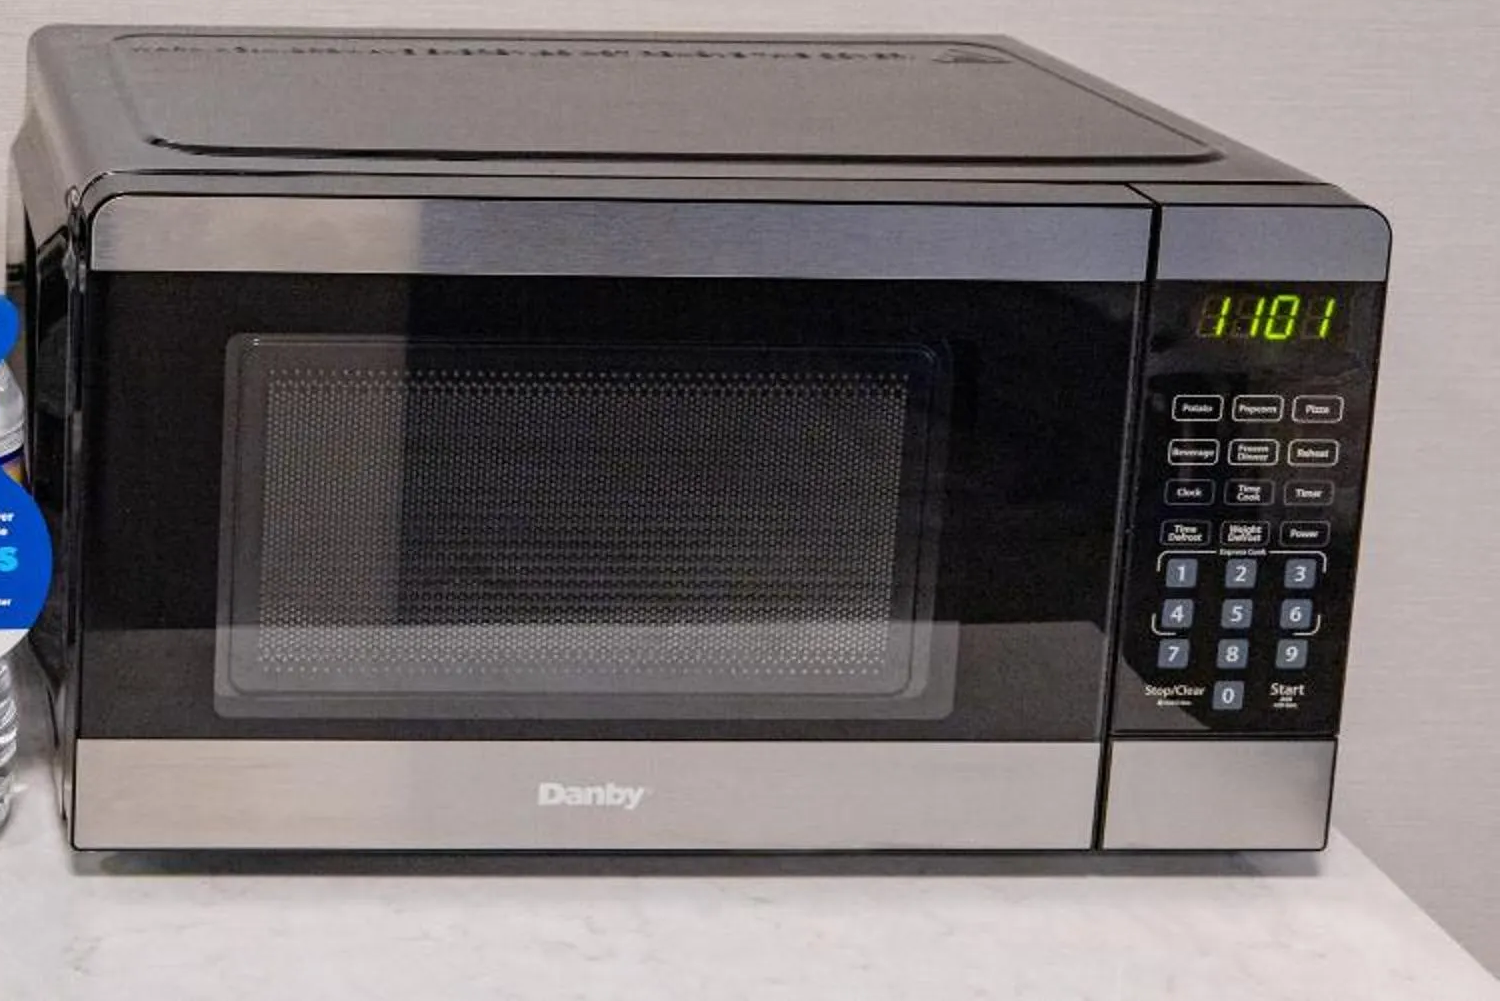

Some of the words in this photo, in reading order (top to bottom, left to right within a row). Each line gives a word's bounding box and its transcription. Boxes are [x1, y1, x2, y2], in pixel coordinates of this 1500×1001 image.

[1239, 404, 1277, 415] Popcorn
[1305, 405, 1330, 414] Pizza
[1171, 448, 1215, 458] Beverage
[1297, 449, 1329, 458] Reheat
[1176, 488, 1202, 497] Clock
[1238, 484, 1261, 493] Time
[1295, 488, 1323, 498] Timer
[1236, 492, 1261, 501] Cook
[1174, 525, 1197, 533] Time
[1229, 525, 1262, 534] Weight
[1290, 529, 1319, 539] Power
[1167, 532, 1202, 542] Defrost
[1227, 532, 1262, 542] Defrost
[1176, 566, 1186, 582] 1
[1235, 566, 1247, 582] 2
[1294, 566, 1306, 582] 3
[1169, 605, 1184, 623] 4
[1230, 606, 1243, 622] 5
[1289, 606, 1303, 622] 6
[1167, 646, 1180, 662] 7
[1225, 646, 1239, 663] 8
[1285, 646, 1299, 663] 9
[1144, 684, 1206, 698] Stop/Clear
[1270, 682, 1306, 696] Start
[1221, 687, 1235, 704] 0
[537, 782, 645, 811] Danby
